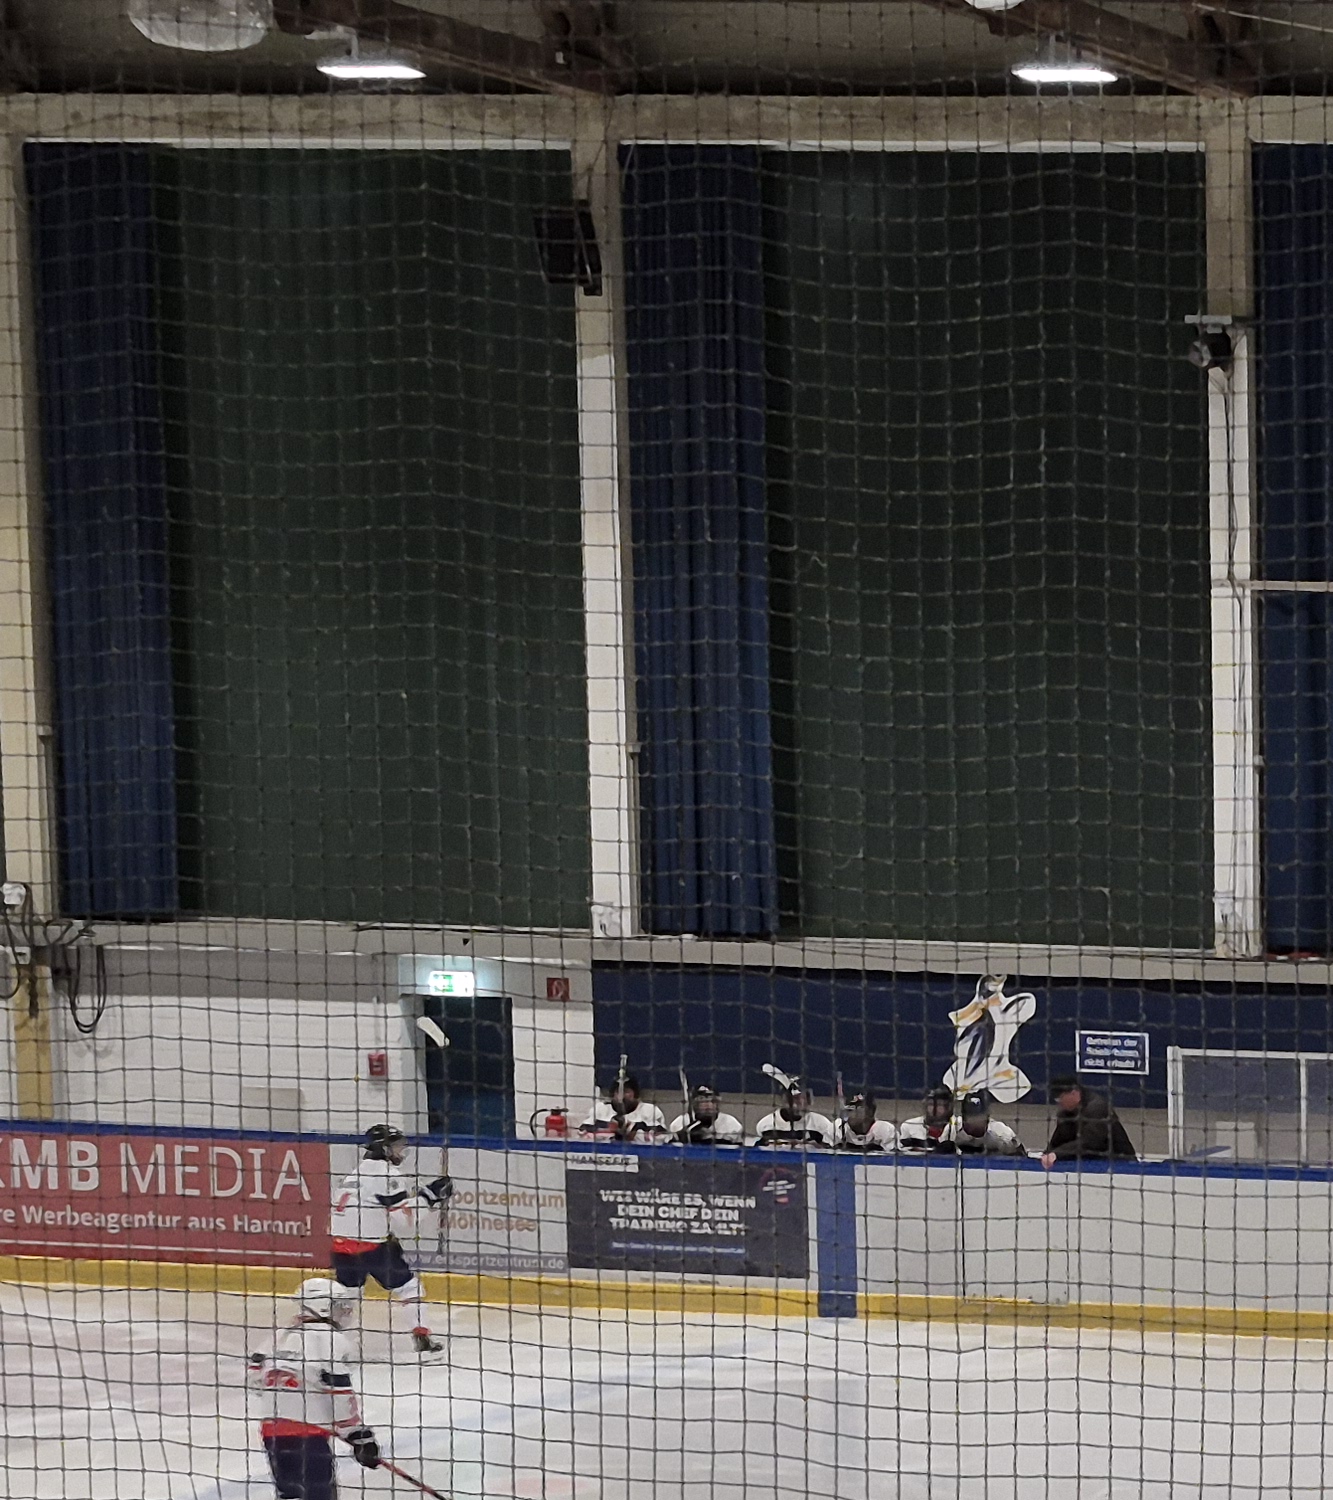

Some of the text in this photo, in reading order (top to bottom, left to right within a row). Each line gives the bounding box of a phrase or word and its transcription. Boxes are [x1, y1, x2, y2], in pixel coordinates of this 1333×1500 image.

[120, 1142, 311, 1201] MEDIA
[452, 1189, 564, 1209] portzentrum
[21, 1203, 181, 1234] Werbeagentur
[187, 1215, 227, 1231] aus
[233, 1214, 312, 1236] Hamm!
[617, 1204, 739, 1221] DEIN CHEF DEIN
